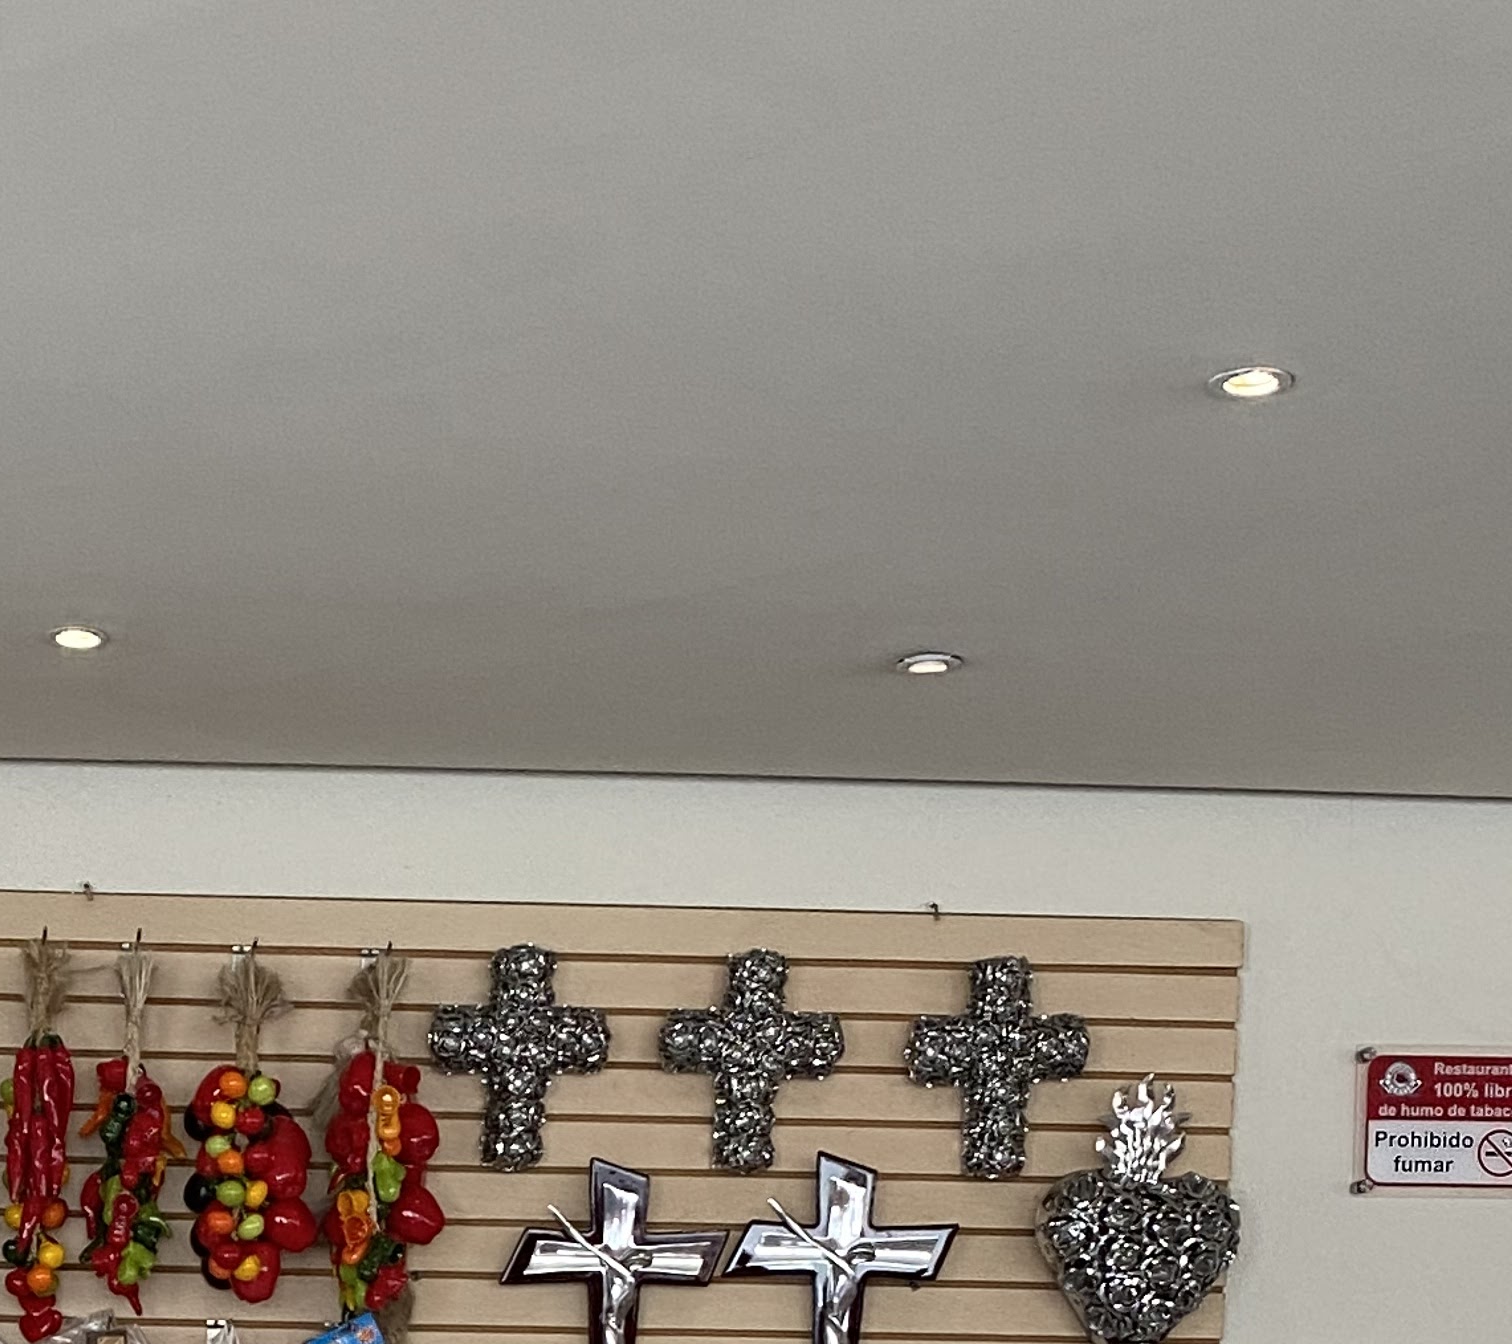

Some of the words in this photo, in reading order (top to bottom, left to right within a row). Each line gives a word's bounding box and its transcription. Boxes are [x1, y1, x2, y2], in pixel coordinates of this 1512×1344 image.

[1434, 1082, 1479, 1098] 100%
[1378, 1104, 1396, 1117] de
[1401, 1104, 1443, 1117] humo
[1447, 1104, 1466, 1117] de
[1470, 1104, 1512, 1117] tabac
[1375, 1131, 1474, 1148] Prohibido
[1394, 1156, 1454, 1172] fumar
